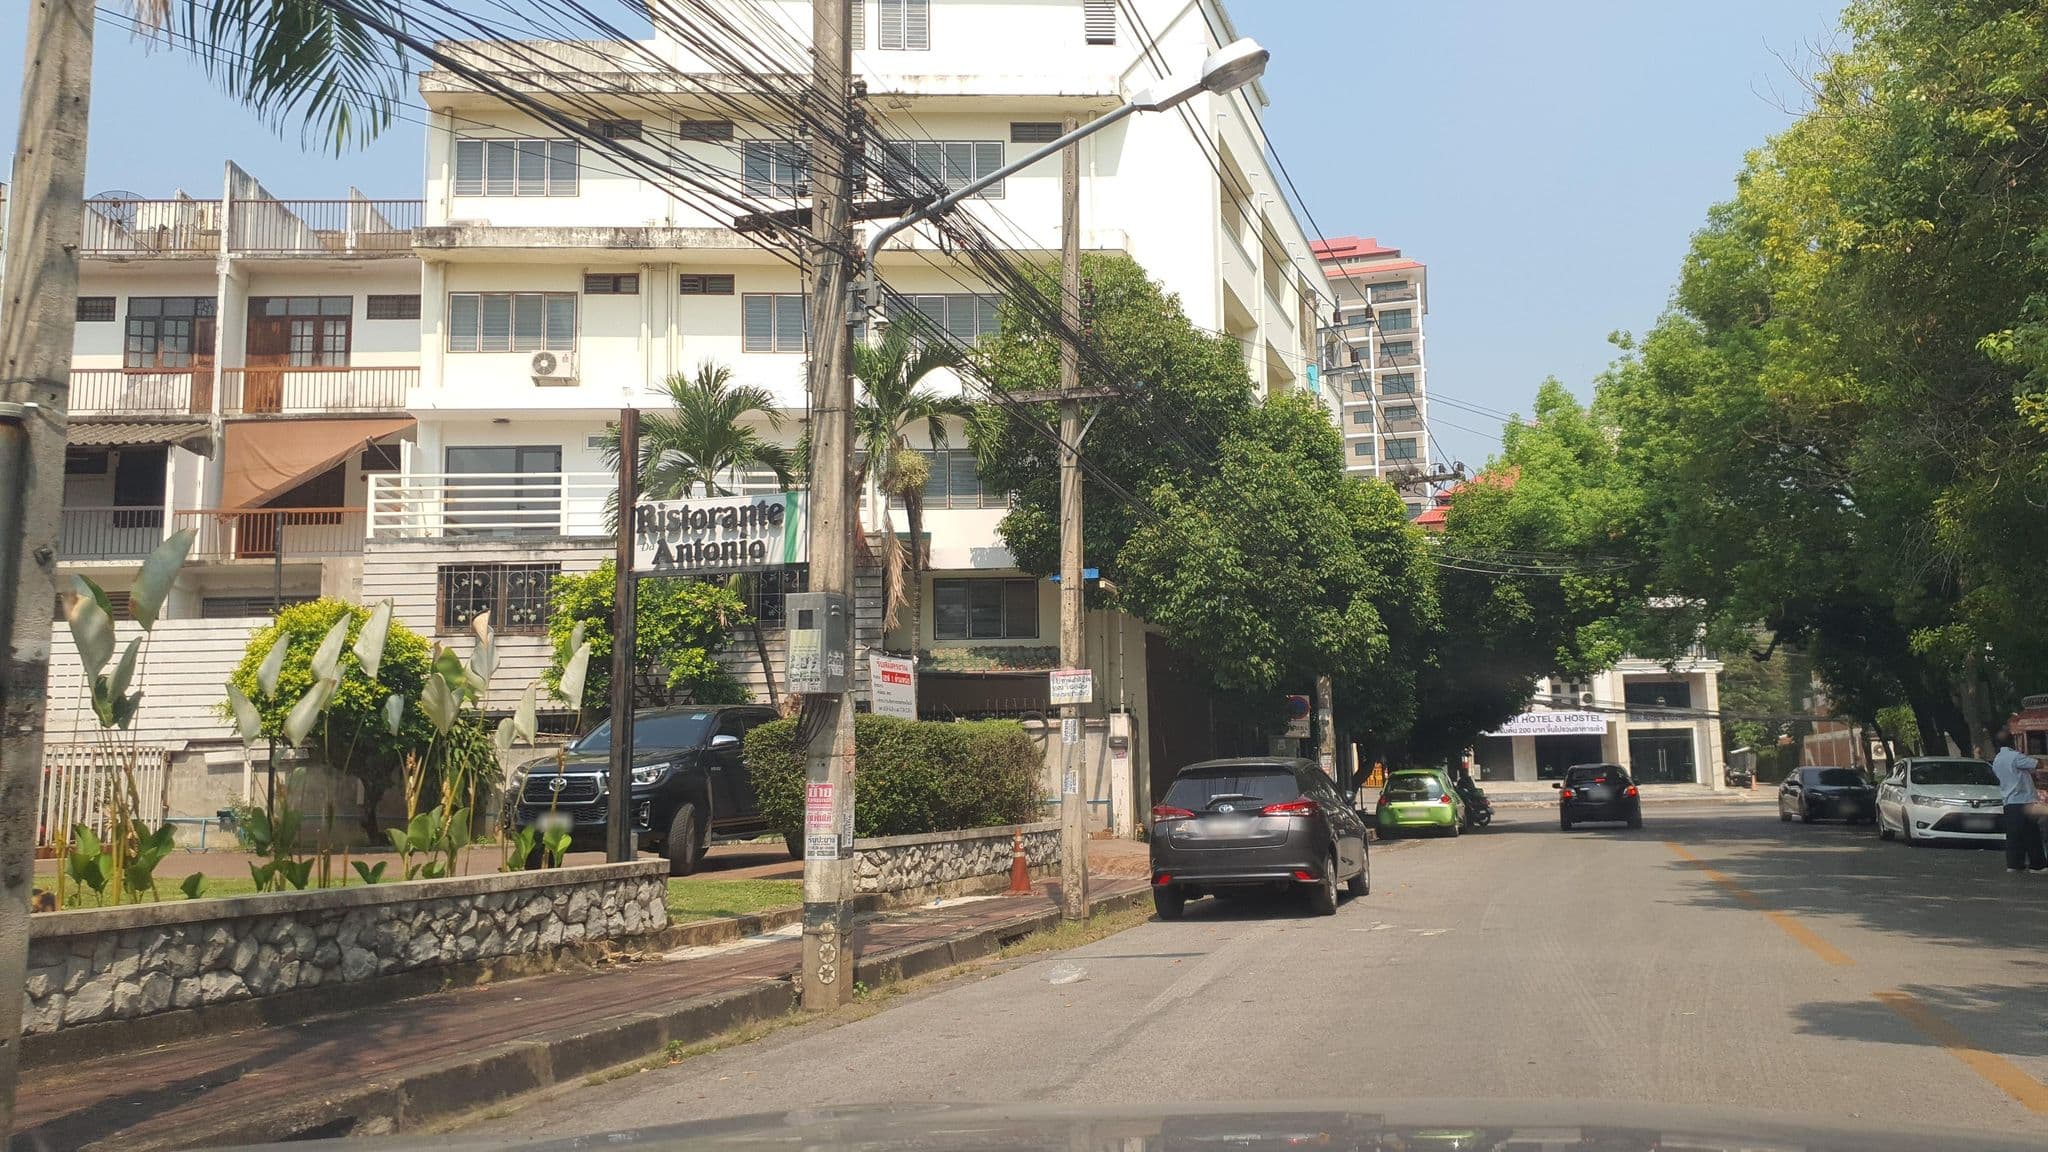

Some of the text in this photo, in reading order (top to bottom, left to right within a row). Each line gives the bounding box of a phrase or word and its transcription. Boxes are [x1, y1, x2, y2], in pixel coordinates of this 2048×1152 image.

[636, 500, 785, 533] Ristorante
[652, 539, 766, 565] Antonio
[1522, 715, 1554, 723] HOTEL
[1564, 714, 1603, 722] HOSTEL
